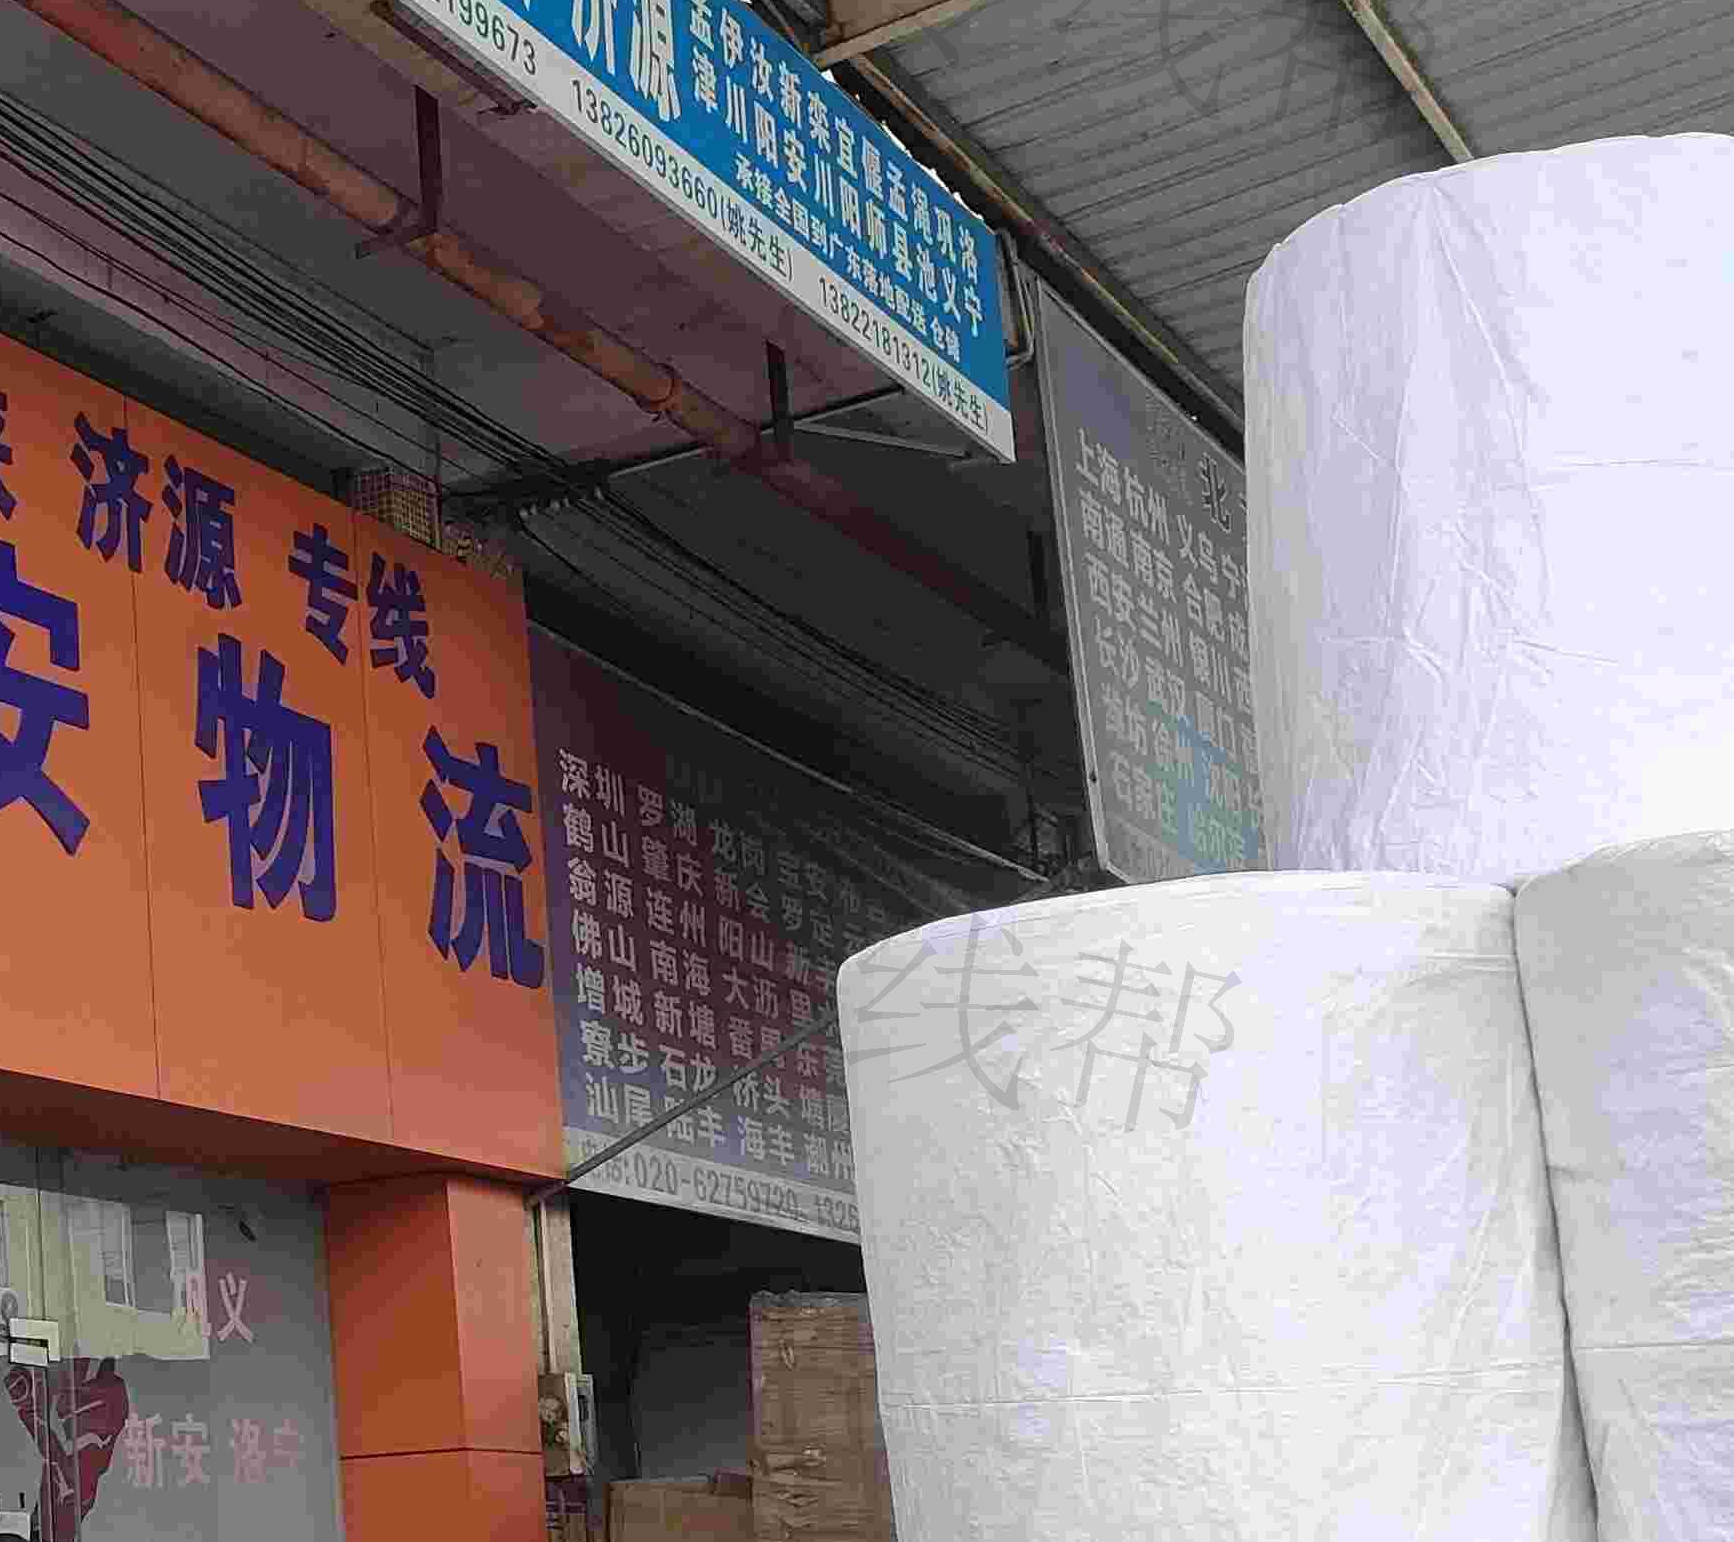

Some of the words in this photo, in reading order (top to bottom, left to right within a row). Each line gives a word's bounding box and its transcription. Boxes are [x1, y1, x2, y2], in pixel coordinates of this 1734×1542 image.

[570, 78, 795, 284] 13826093660(姚先生)
[818, 275, 989, 434] 13822181312(姚先生)
[72, 412, 242, 611] 济源
[289, 523, 436, 700] 专线
[558, 747, 627, 820] 深圳
[636, 784, 699, 849] 罗湖
[562, 802, 632, 870] 鹤山
[571, 908, 638, 974] 佛山
[649, 939, 713, 998] 南海
[717, 915, 776, 973] 阳山
[575, 963, 645, 1027] 增城
[585, 1072, 655, 1127] 汕尾
[123, 1412, 211, 1489] 新安
